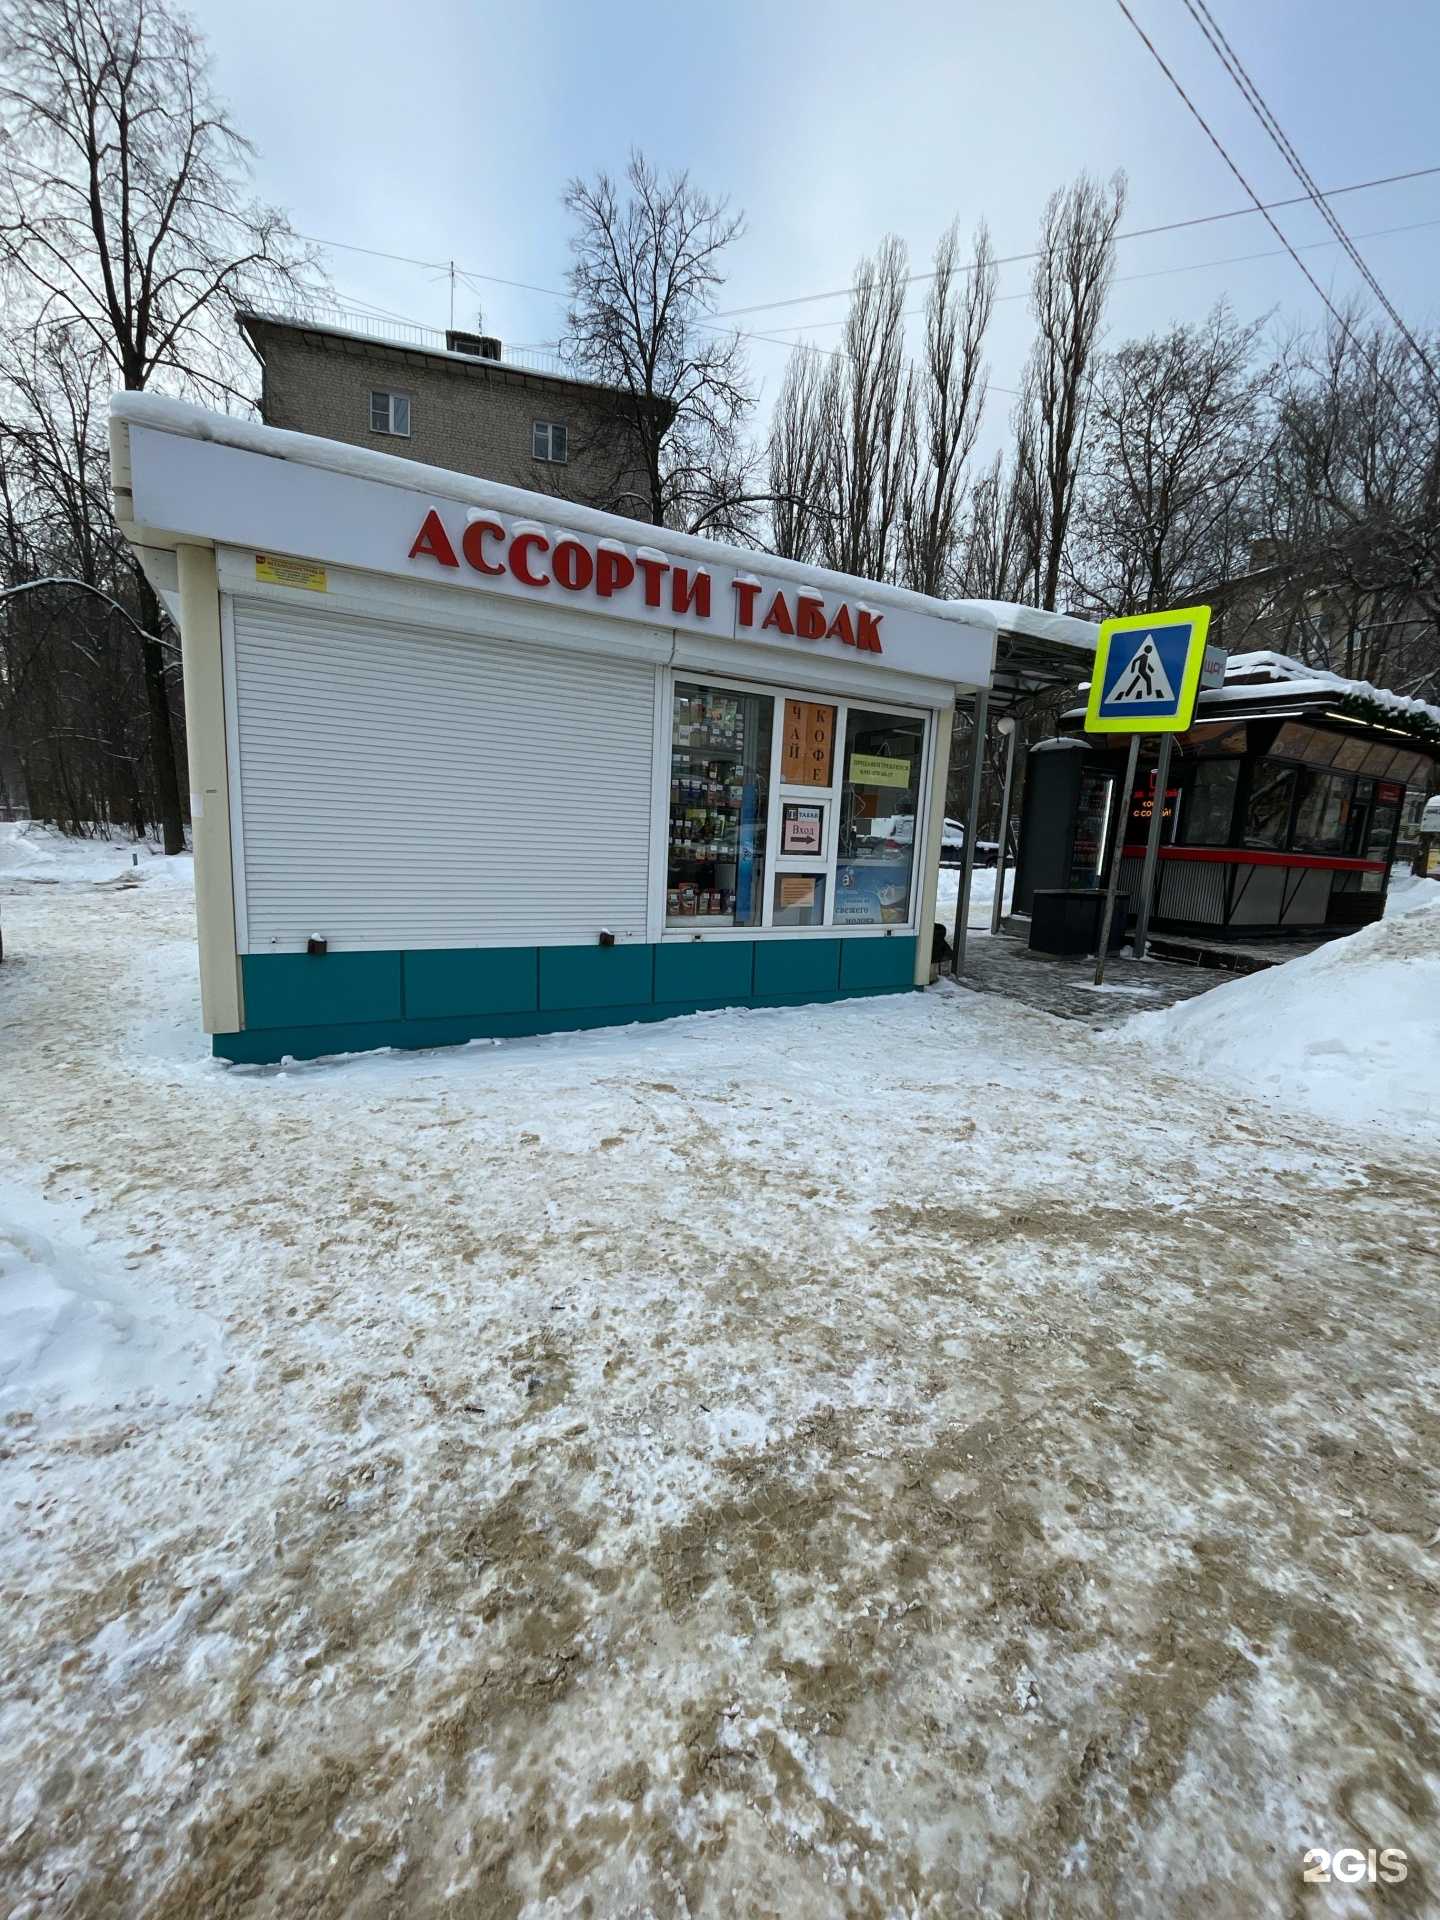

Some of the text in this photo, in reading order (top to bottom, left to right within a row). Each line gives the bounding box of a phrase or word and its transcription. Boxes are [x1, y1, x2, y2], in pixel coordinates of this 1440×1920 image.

[408, 506, 885, 653] АССОРТИ ТАБАК
[789, 706, 801, 759] ЧАЙ
[812, 709, 826, 781] КОФЕ
[793, 825, 814, 836] Вход
